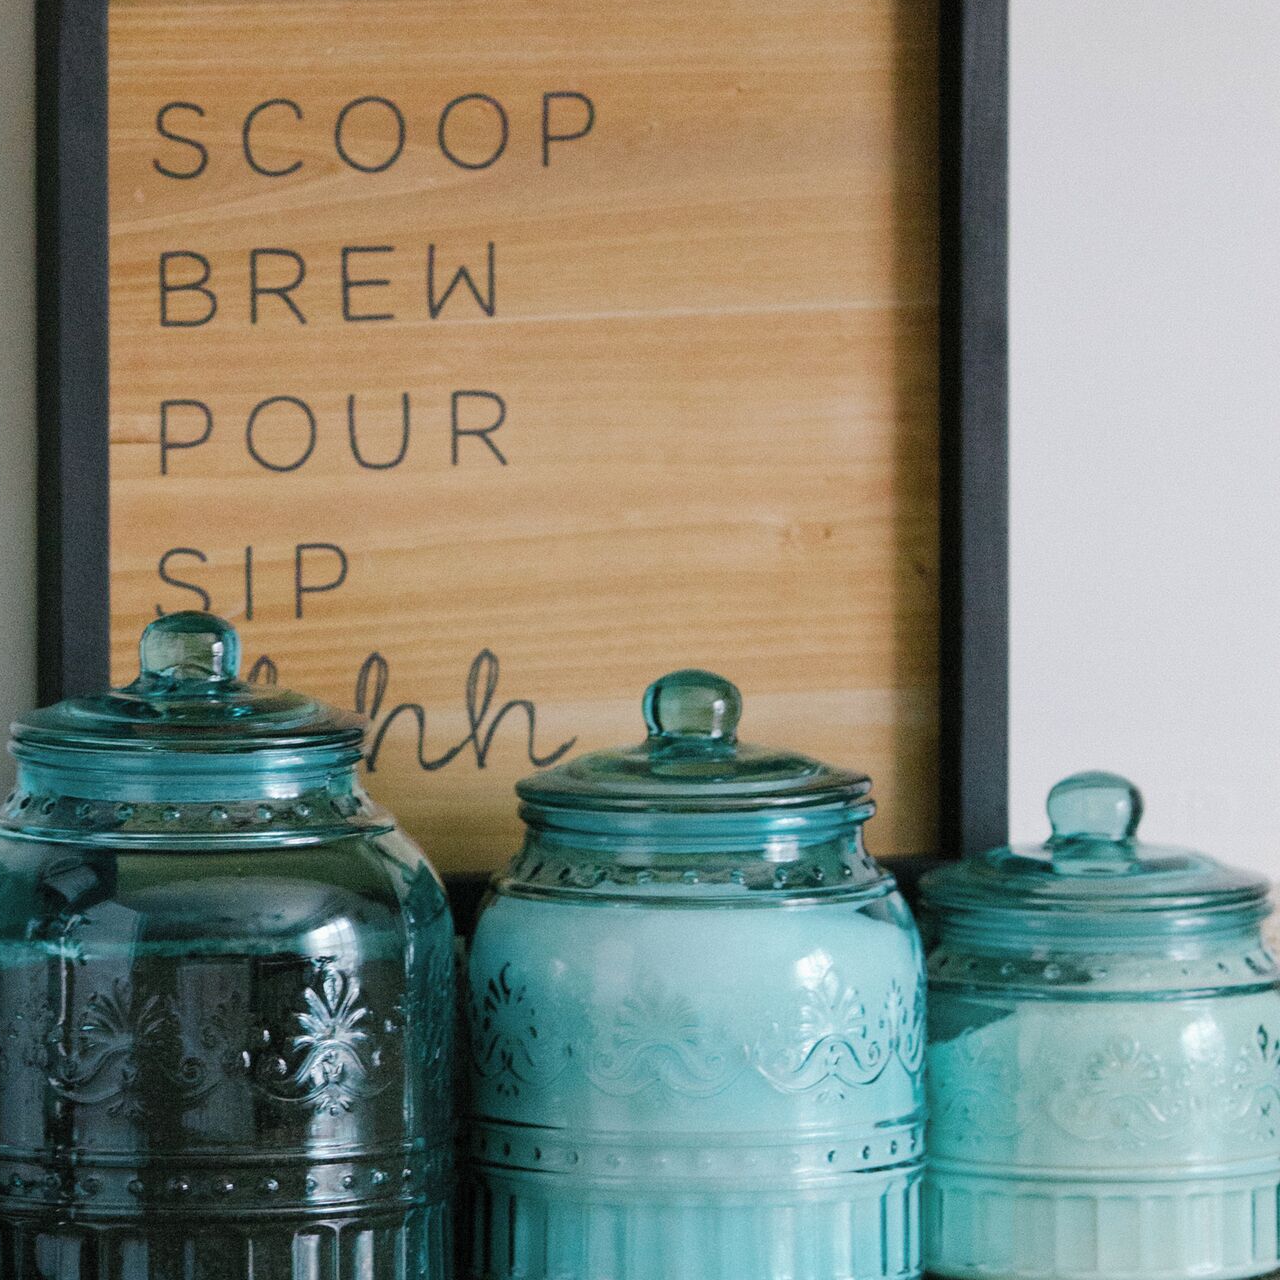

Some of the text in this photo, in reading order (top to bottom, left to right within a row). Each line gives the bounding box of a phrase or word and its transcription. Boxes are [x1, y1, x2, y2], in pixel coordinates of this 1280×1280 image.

[152, 91, 596, 180] SCOOP
[158, 241, 497, 327] BREW
[159, 390, 508, 476] POUR
[155, 542, 349, 621] SIP
